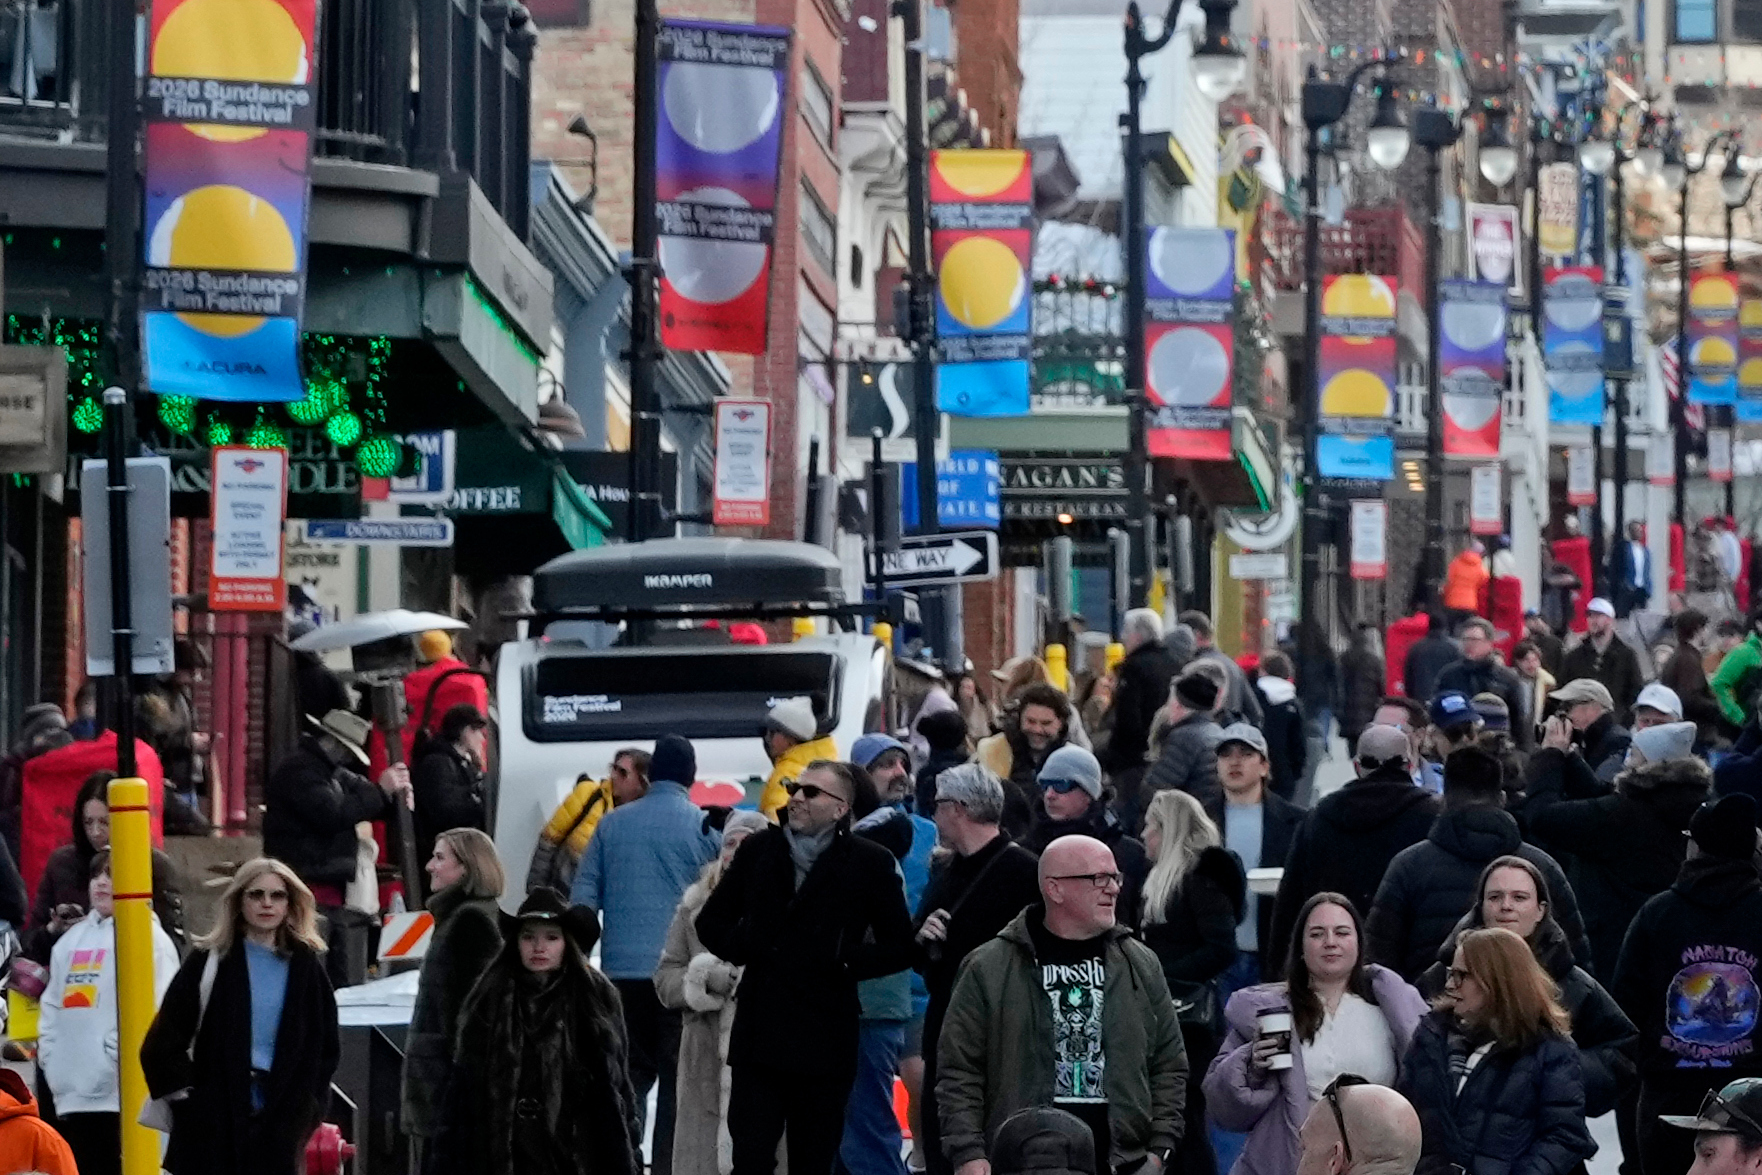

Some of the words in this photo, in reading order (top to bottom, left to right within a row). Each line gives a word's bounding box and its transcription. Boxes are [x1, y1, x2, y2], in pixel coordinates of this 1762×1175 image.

[148, 78, 200, 101] 2026
[203, 81, 310, 106] Sundance
[162, 98, 207, 118] Film
[210, 100, 293, 124] Festival
[146, 270, 194, 290] 2026
[199, 272, 298, 295] Sundance
[162, 289, 203, 309] Film
[207, 292, 282, 313] Festival
[444, 486, 521, 510] OFFEE
[1021, 501, 1126, 517] RESTAURAN
[915, 547, 950, 567] WAY
